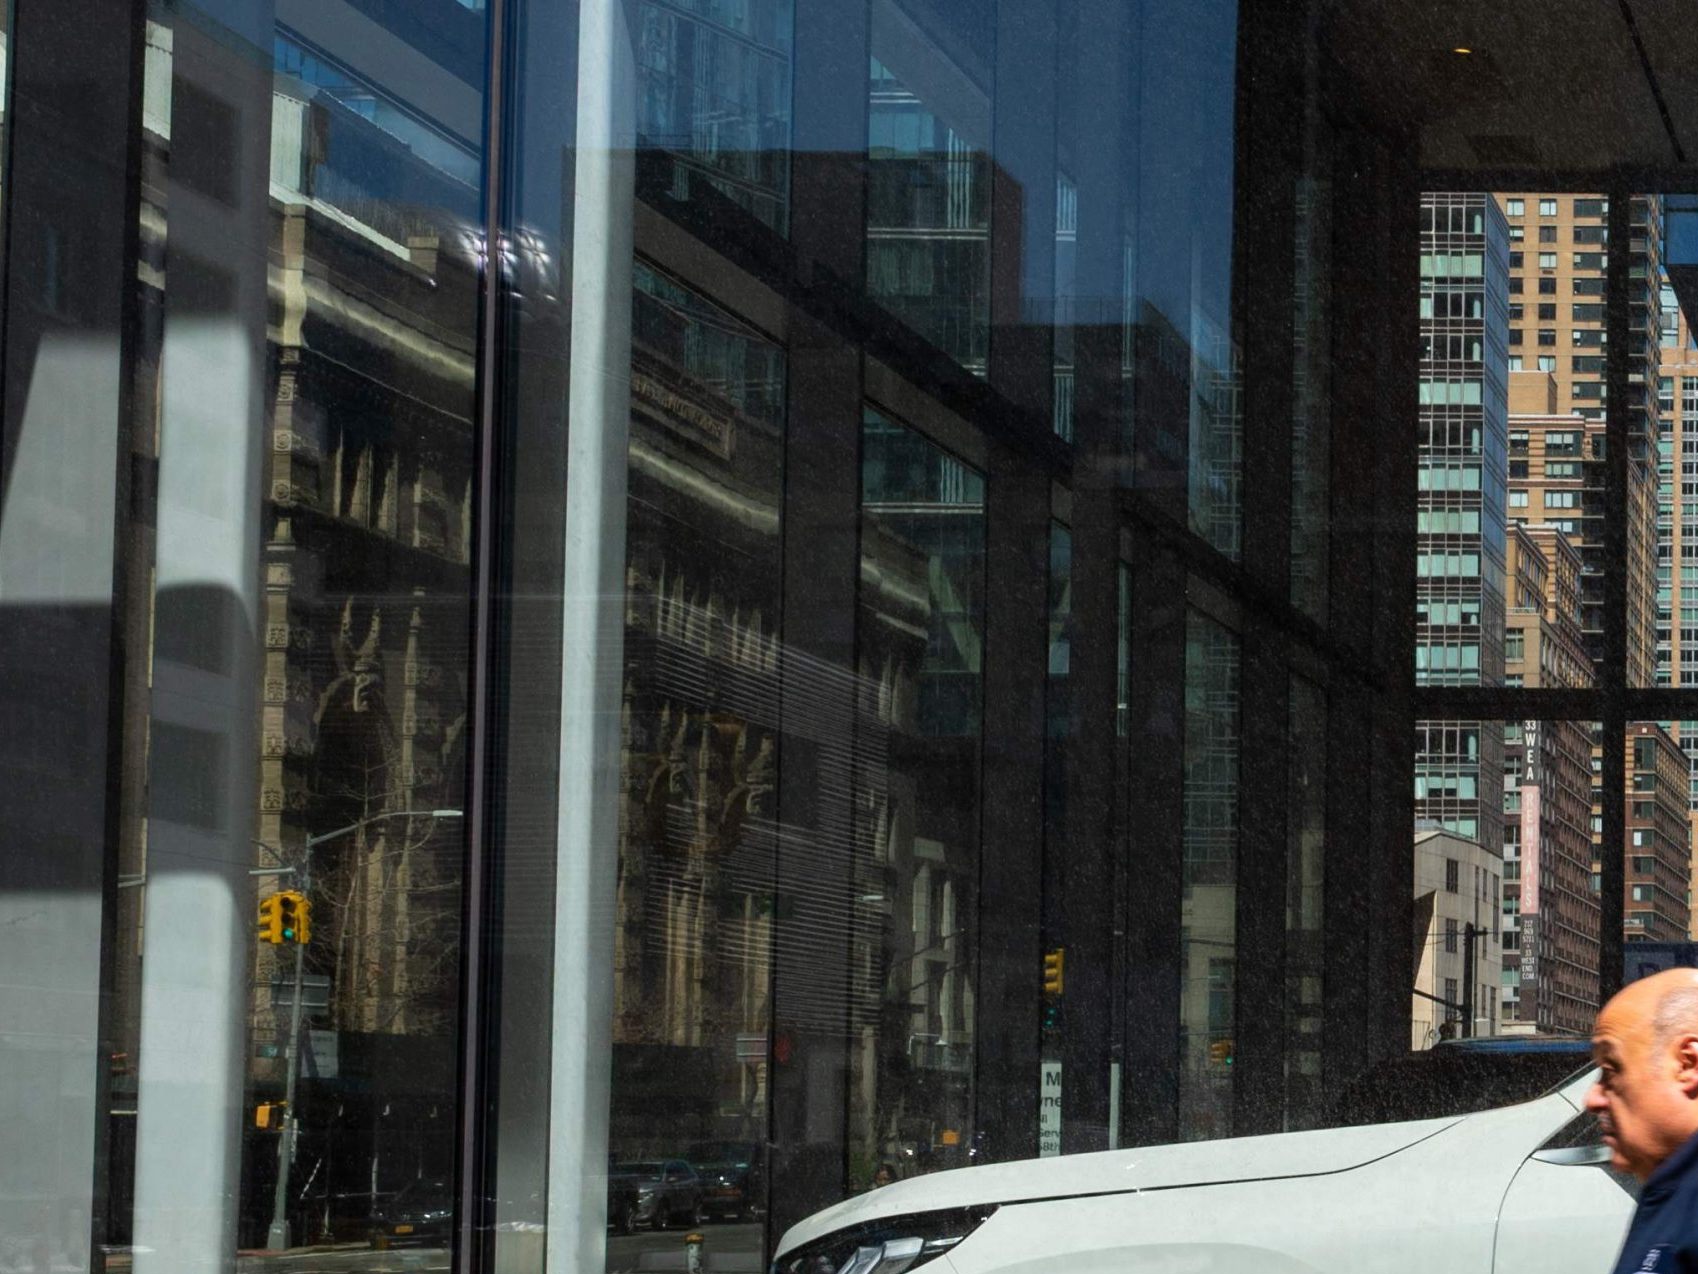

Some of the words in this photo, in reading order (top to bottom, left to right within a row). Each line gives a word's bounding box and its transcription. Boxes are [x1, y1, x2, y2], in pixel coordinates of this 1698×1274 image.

[1524, 719, 1536, 731] 33
[1524, 732, 1536, 780] WEA
[1525, 792, 1534, 908] RENTALS
